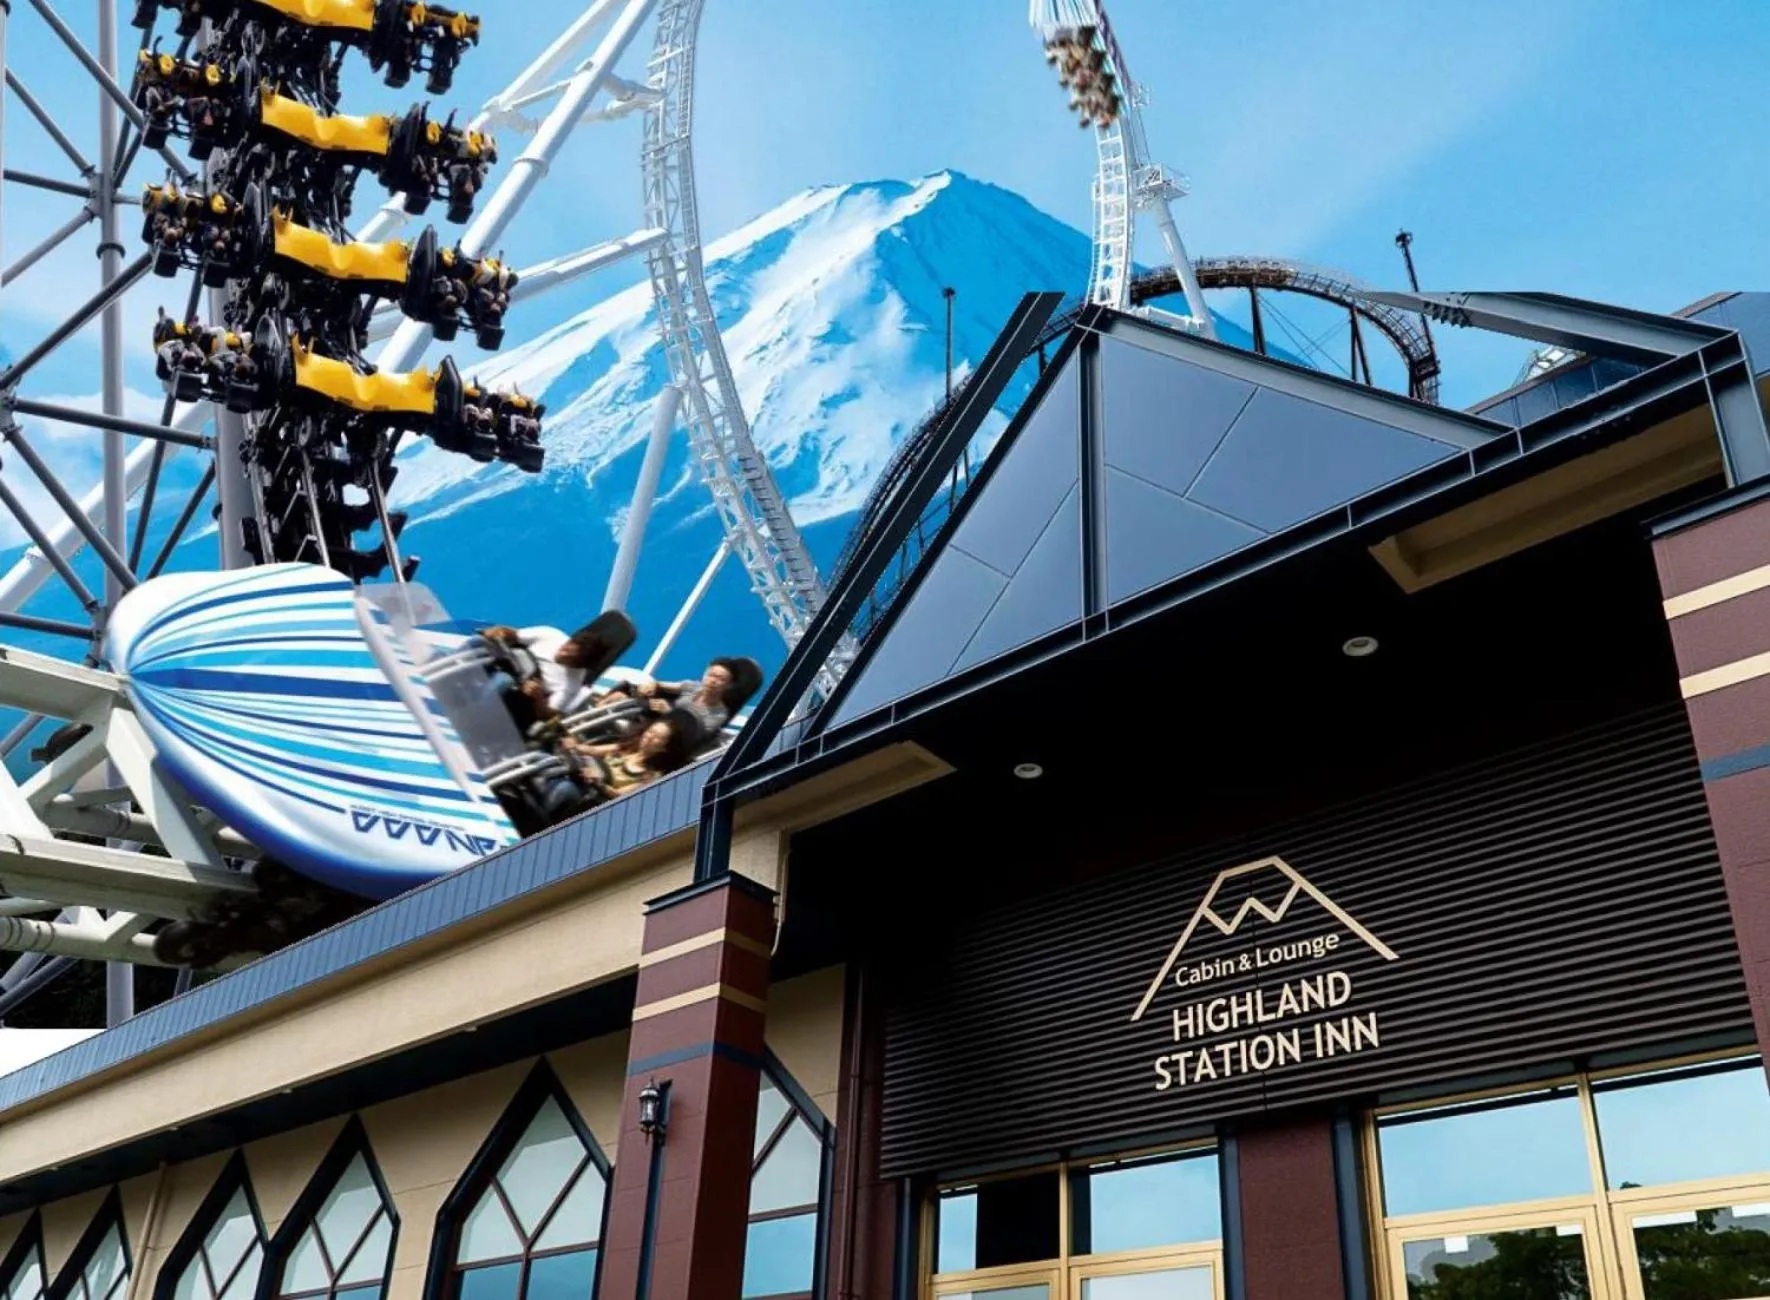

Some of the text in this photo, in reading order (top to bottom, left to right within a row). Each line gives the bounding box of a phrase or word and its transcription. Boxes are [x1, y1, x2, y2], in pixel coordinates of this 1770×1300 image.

[1174, 933, 1340, 987] Cabin & Lounge
[1172, 971, 1352, 1042] HIGHLAND
[1154, 1012, 1379, 1090] STATION INN
